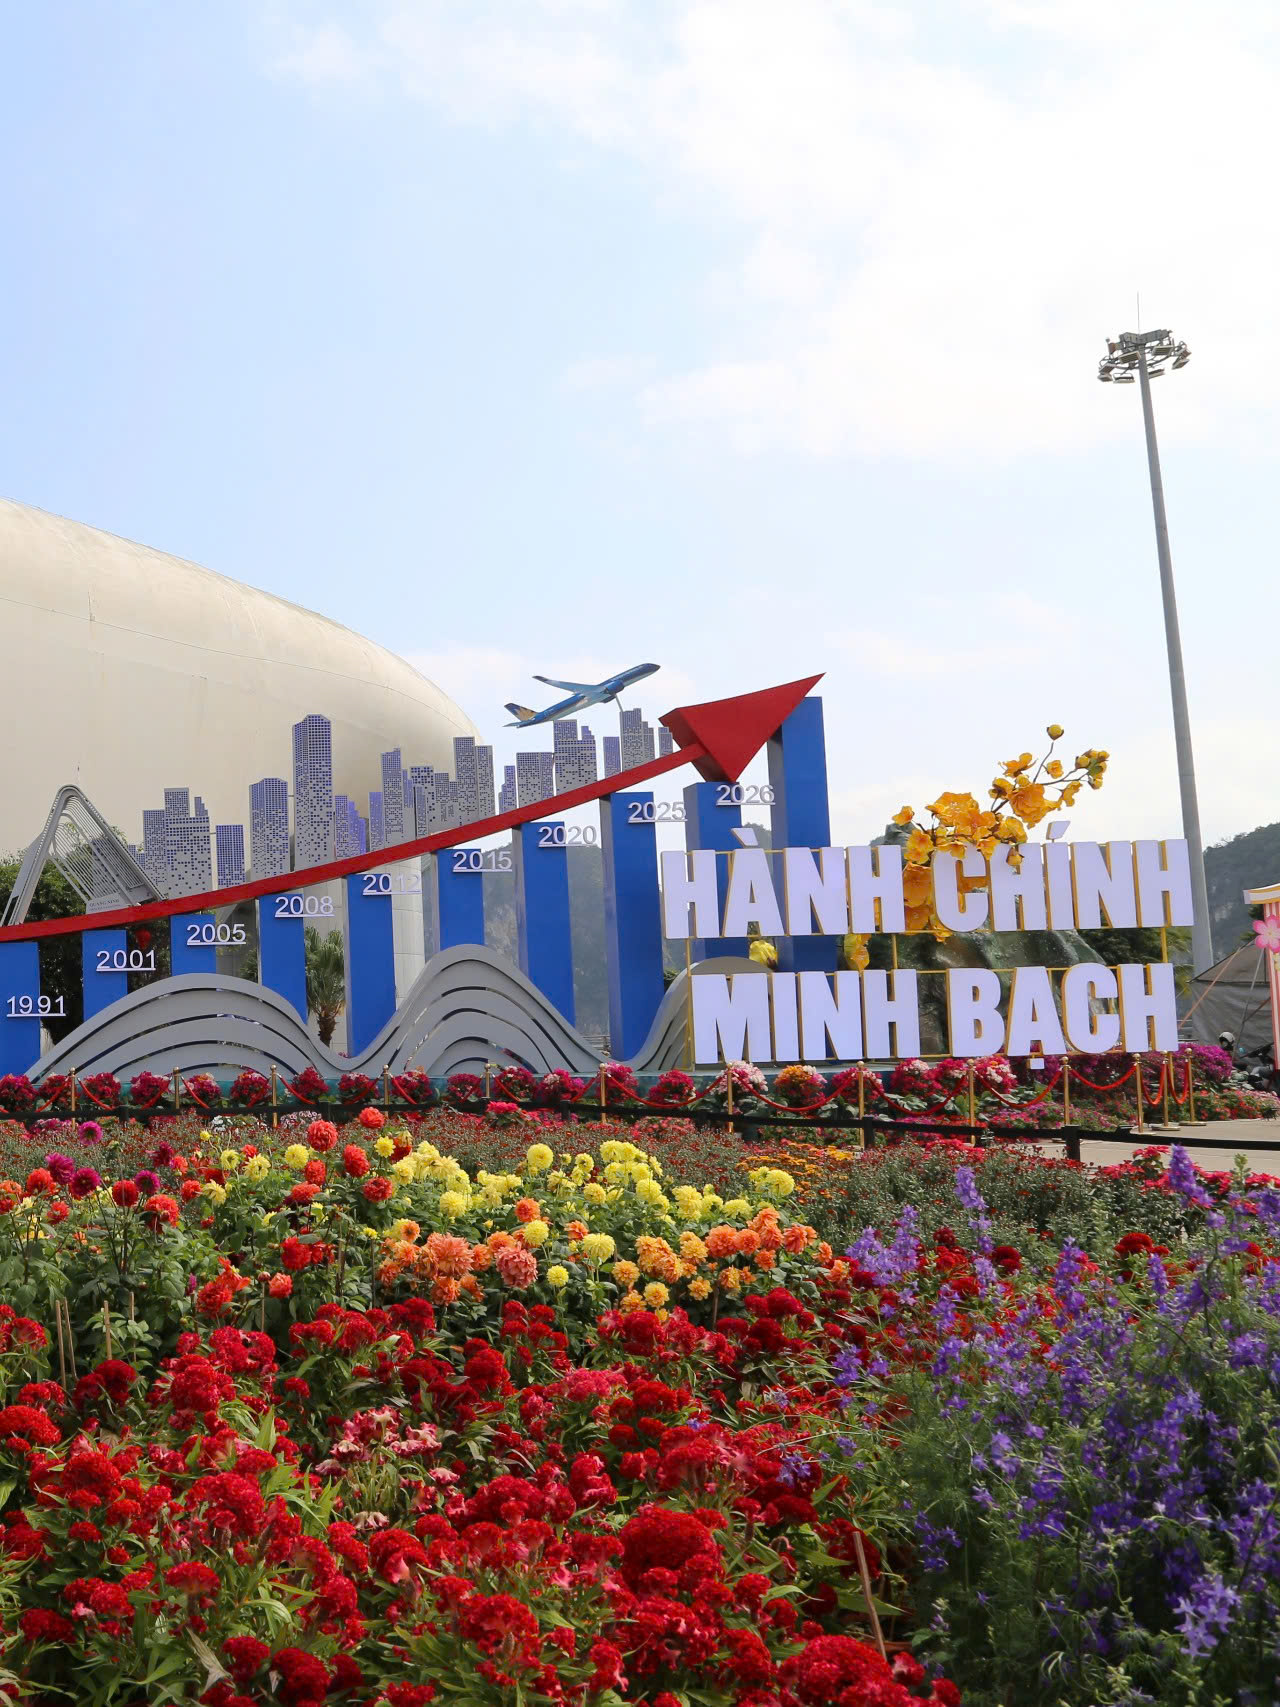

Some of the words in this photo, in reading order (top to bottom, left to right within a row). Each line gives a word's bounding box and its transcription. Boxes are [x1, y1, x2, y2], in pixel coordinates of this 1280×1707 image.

[716, 784, 775, 804] 2026
[628, 801, 687, 822] 2025
[538, 825, 597, 846] 2020
[453, 851, 512, 872] 2015
[362, 874, 421, 894] 2012
[661, 828, 905, 939] HÀNH
[932, 821, 1194, 933] CHÍNH
[275, 896, 334, 916] 2008
[187, 924, 247, 944] 2005
[96, 949, 156, 970] 2001
[7, 995, 65, 1015] 1991
[691, 969, 920, 1064] MINH
[948, 963, 1179, 1070] BẠCH
